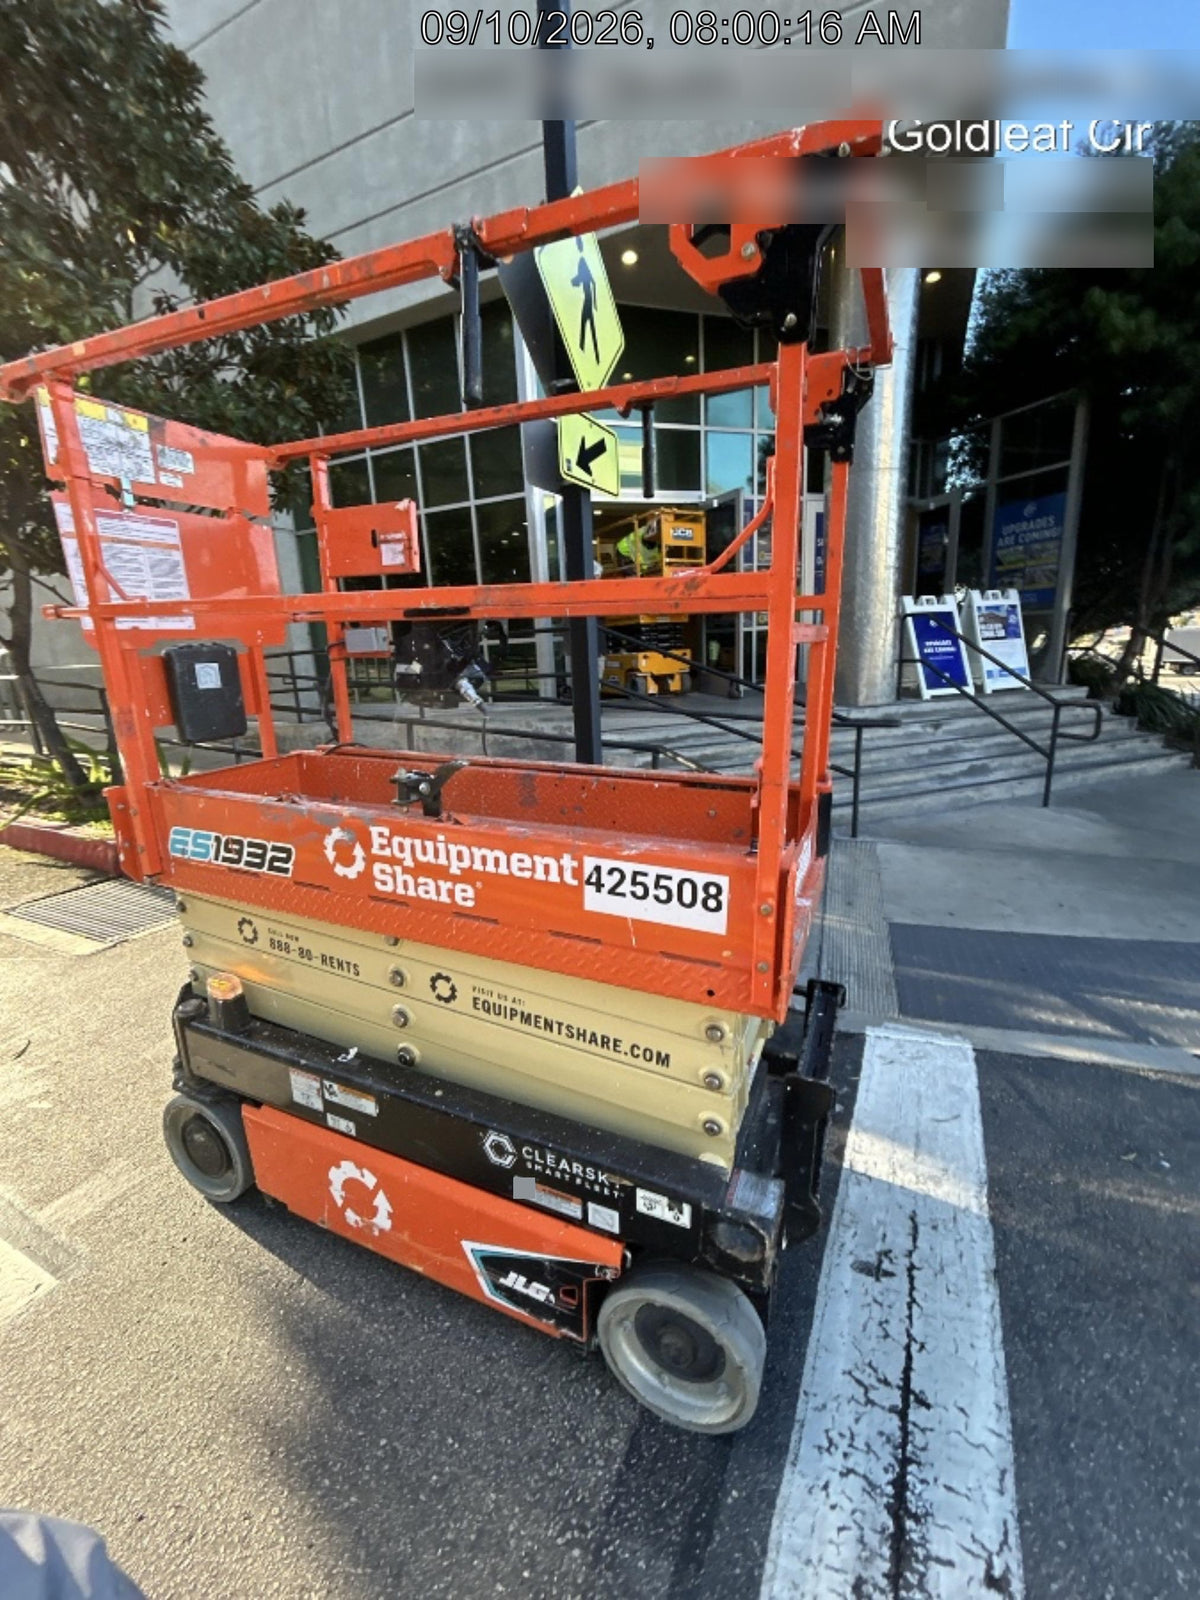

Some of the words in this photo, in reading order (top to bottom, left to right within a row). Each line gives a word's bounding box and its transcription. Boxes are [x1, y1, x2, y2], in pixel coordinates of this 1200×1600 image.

[169, 826, 296, 878] ES1932
[369, 826, 579, 886] Equipment
[372, 861, 476, 908] Share
[585, 865, 723, 913] 425508
[472, 996, 671, 1068] EQUIPMENTSHARE.COM
[522, 1146, 619, 1189] CLEARSK
[499, 1268, 552, 1302] JLG
